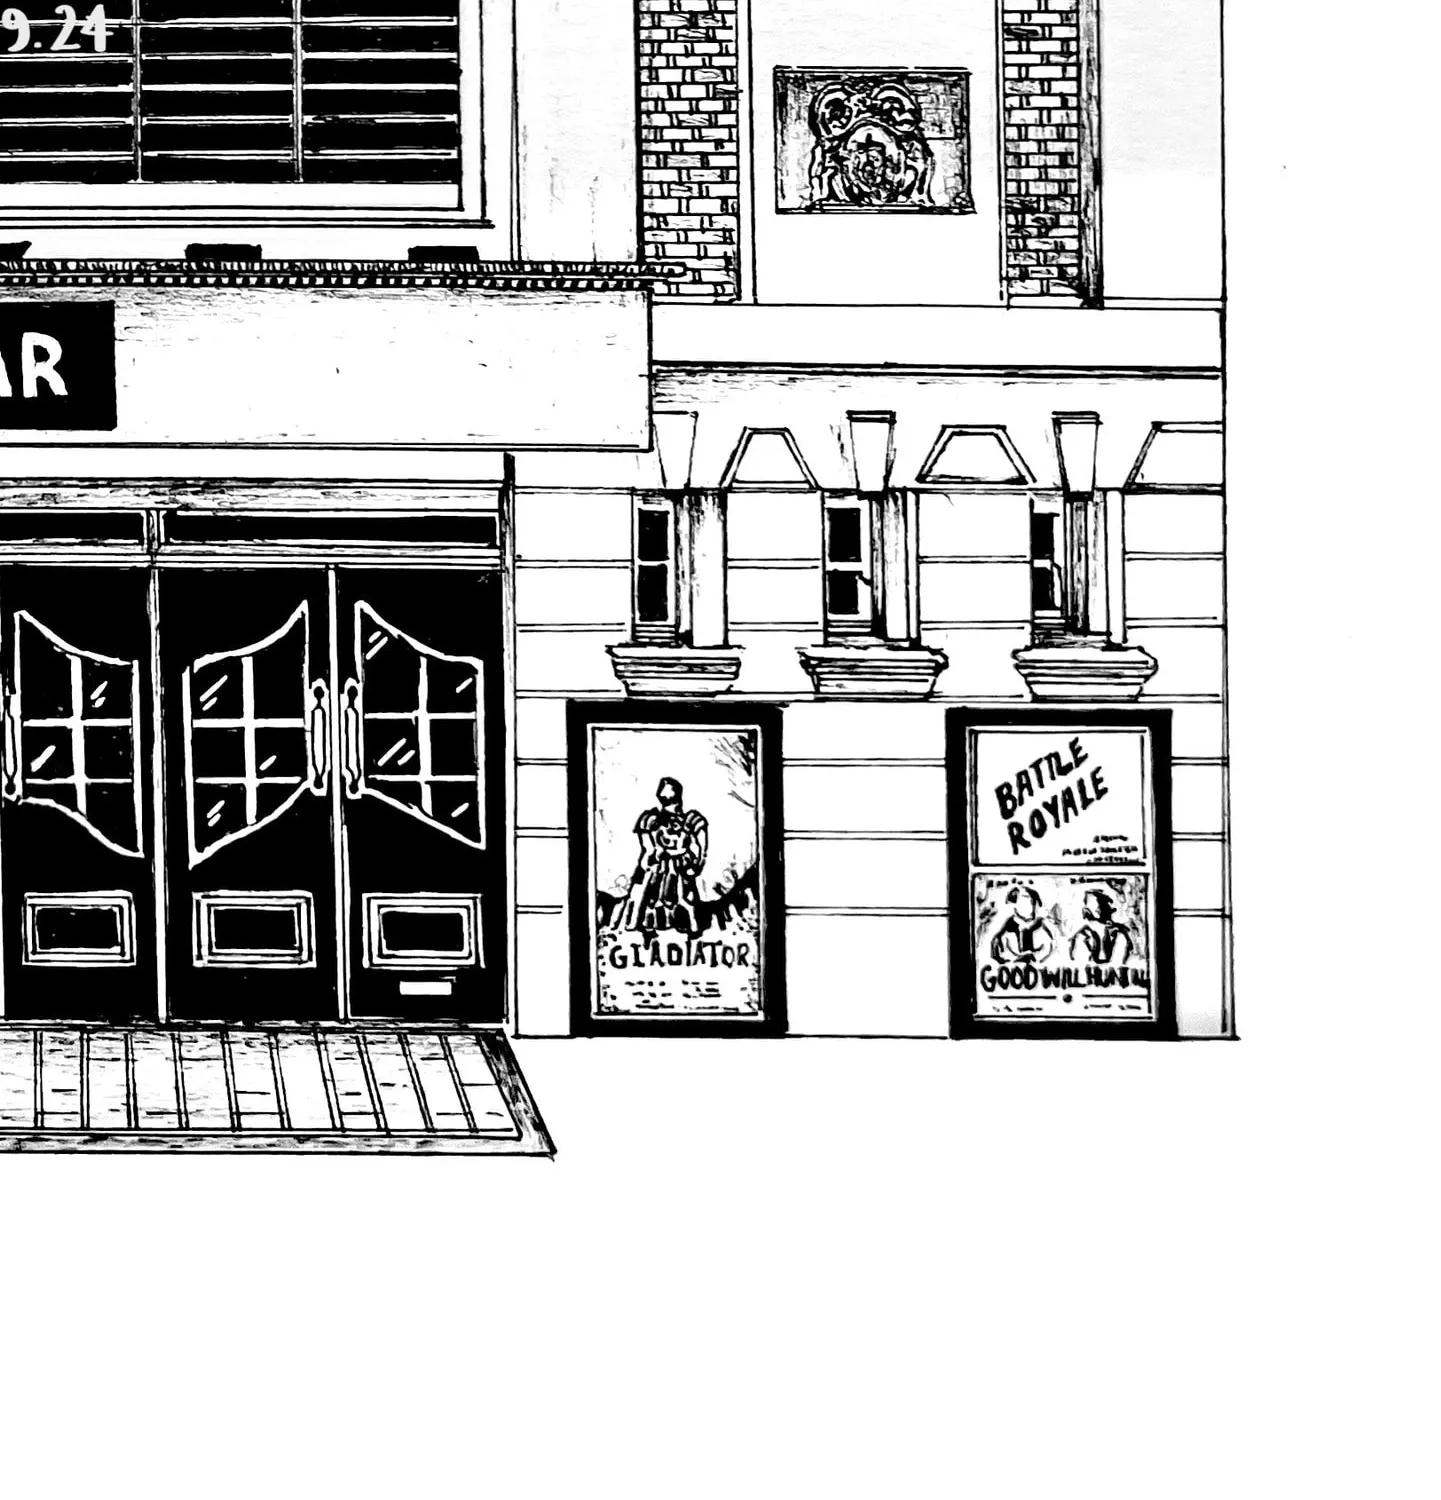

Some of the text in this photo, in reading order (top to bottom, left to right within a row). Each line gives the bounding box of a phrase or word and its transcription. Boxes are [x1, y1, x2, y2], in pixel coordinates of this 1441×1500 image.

[995, 737, 1089, 820] BATTLE
[1007, 766, 1109, 855] ROYALE
[609, 940, 750, 969] GLADIATOR
[980, 964, 1039, 992] GOOD
